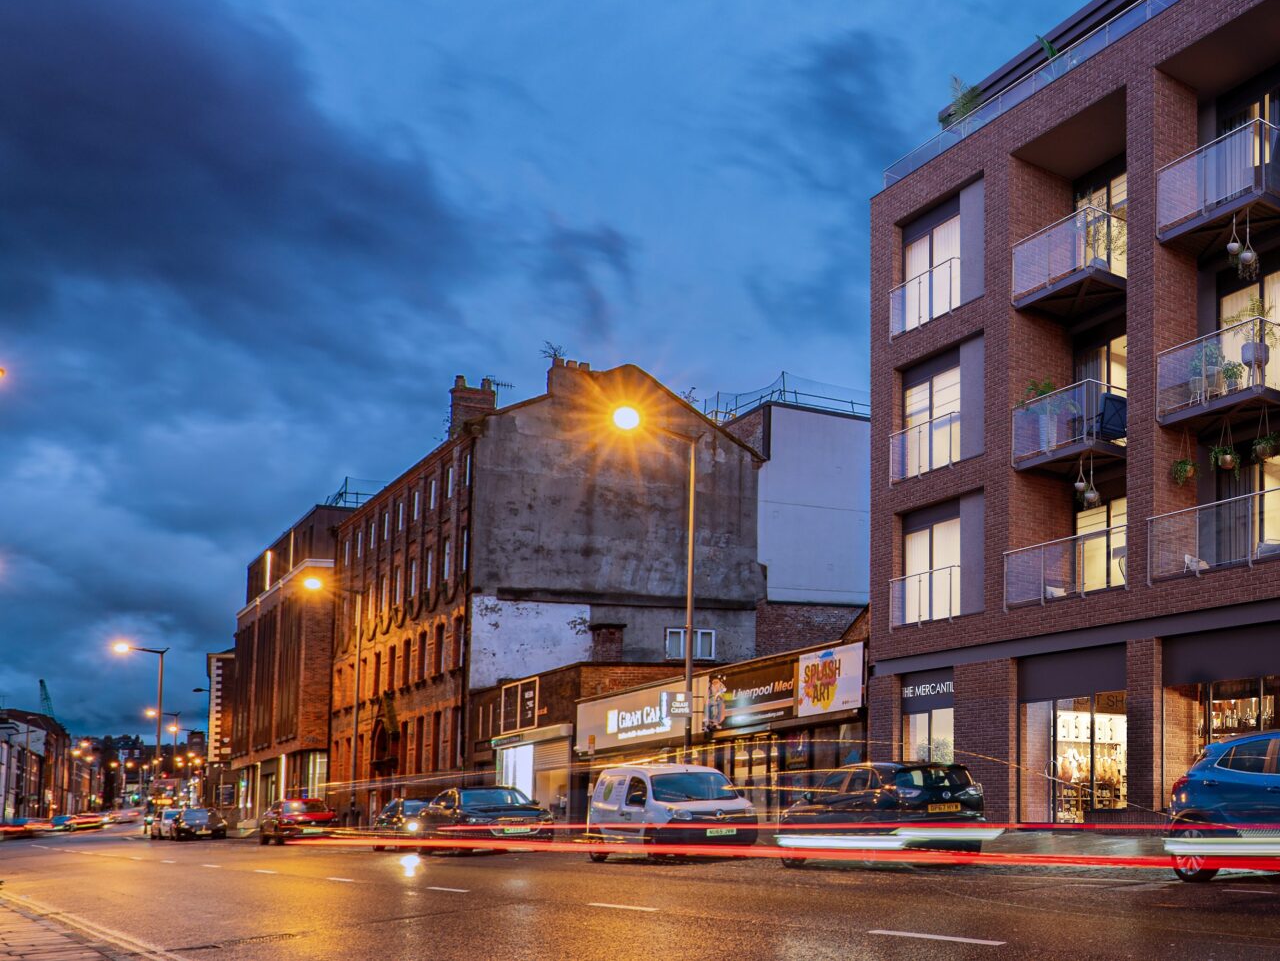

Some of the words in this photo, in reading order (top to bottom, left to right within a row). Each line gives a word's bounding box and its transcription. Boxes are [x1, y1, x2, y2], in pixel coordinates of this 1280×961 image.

[804, 658, 841, 684] SPLASH
[733, 682, 773, 700] Liverpool
[774, 678, 794, 693] Med
[812, 681, 830, 703] ART
